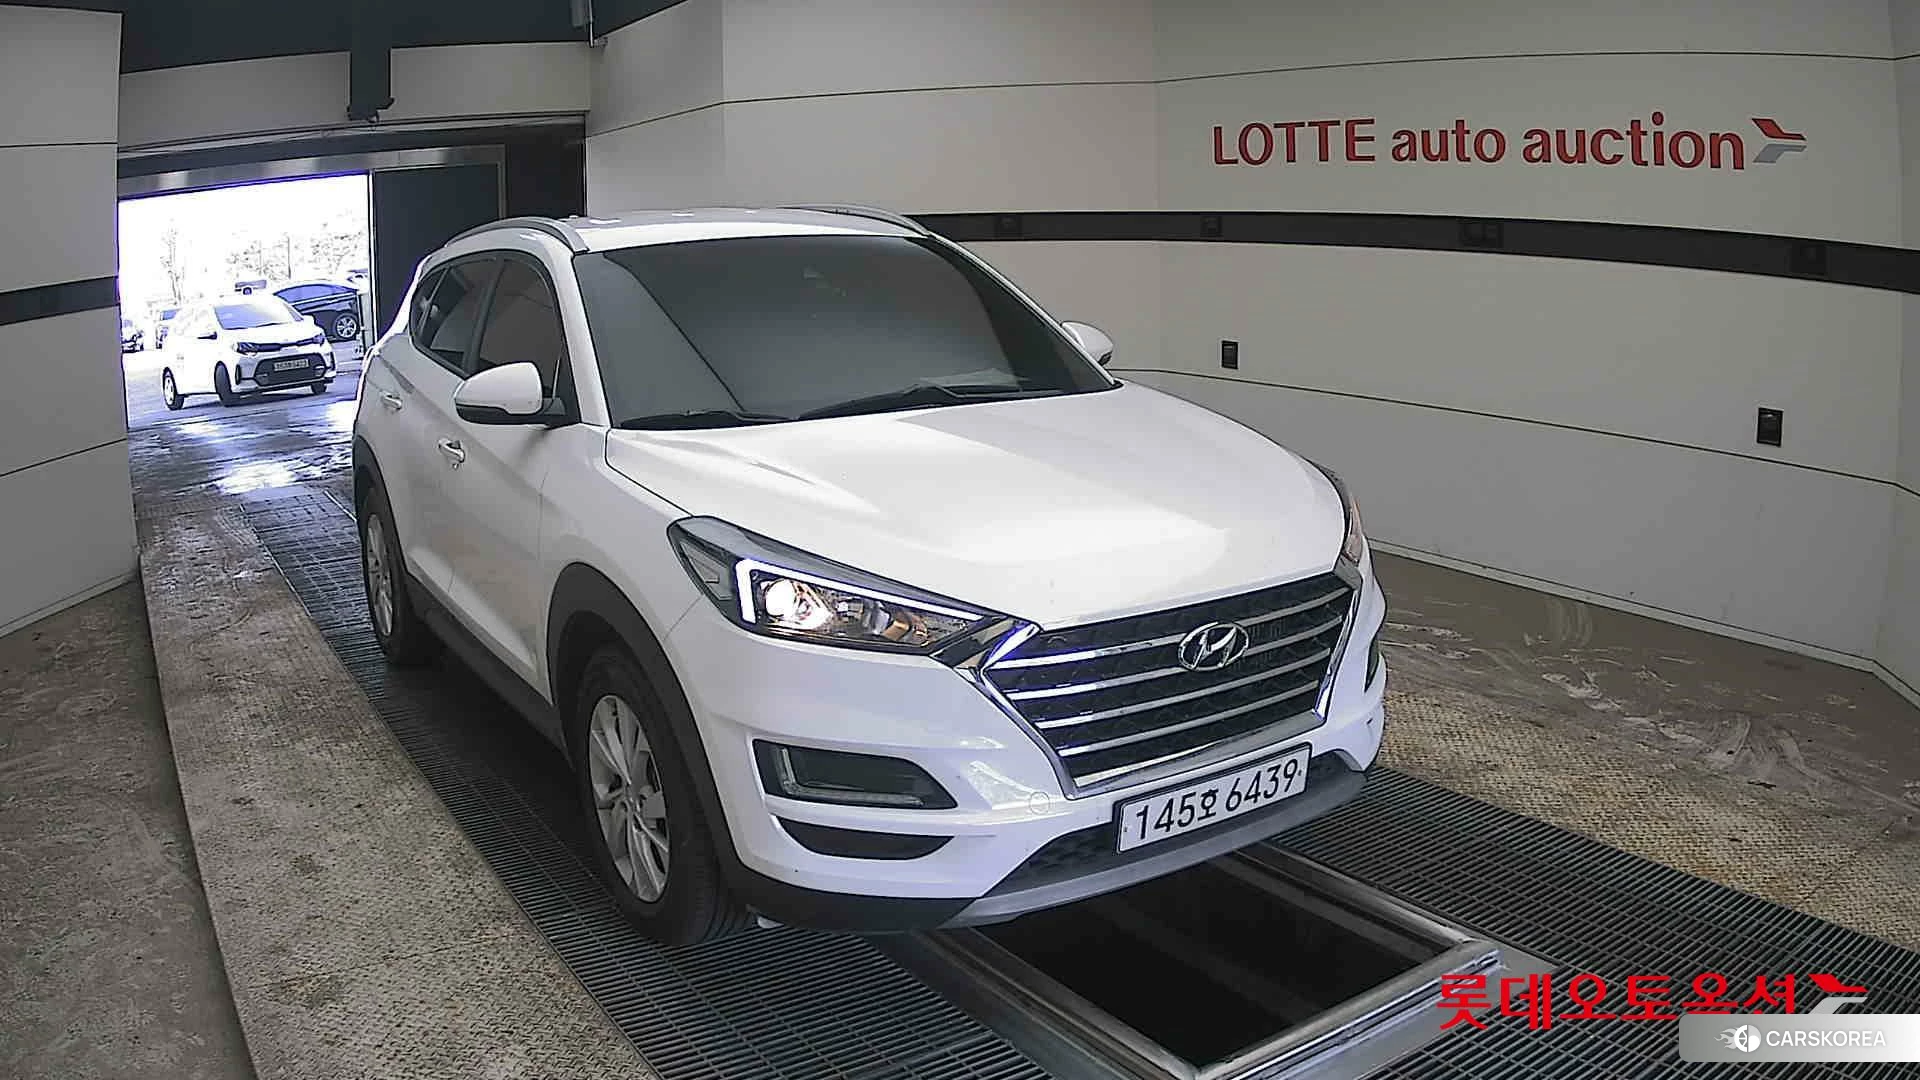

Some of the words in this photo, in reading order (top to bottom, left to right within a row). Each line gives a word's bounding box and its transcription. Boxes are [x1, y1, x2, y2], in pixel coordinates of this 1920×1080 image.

[1213, 118, 1376, 165] LOTTE
[1391, 119, 1506, 163] auto
[1520, 112, 1745, 169] auction
[1225, 758, 1298, 812] 6439
